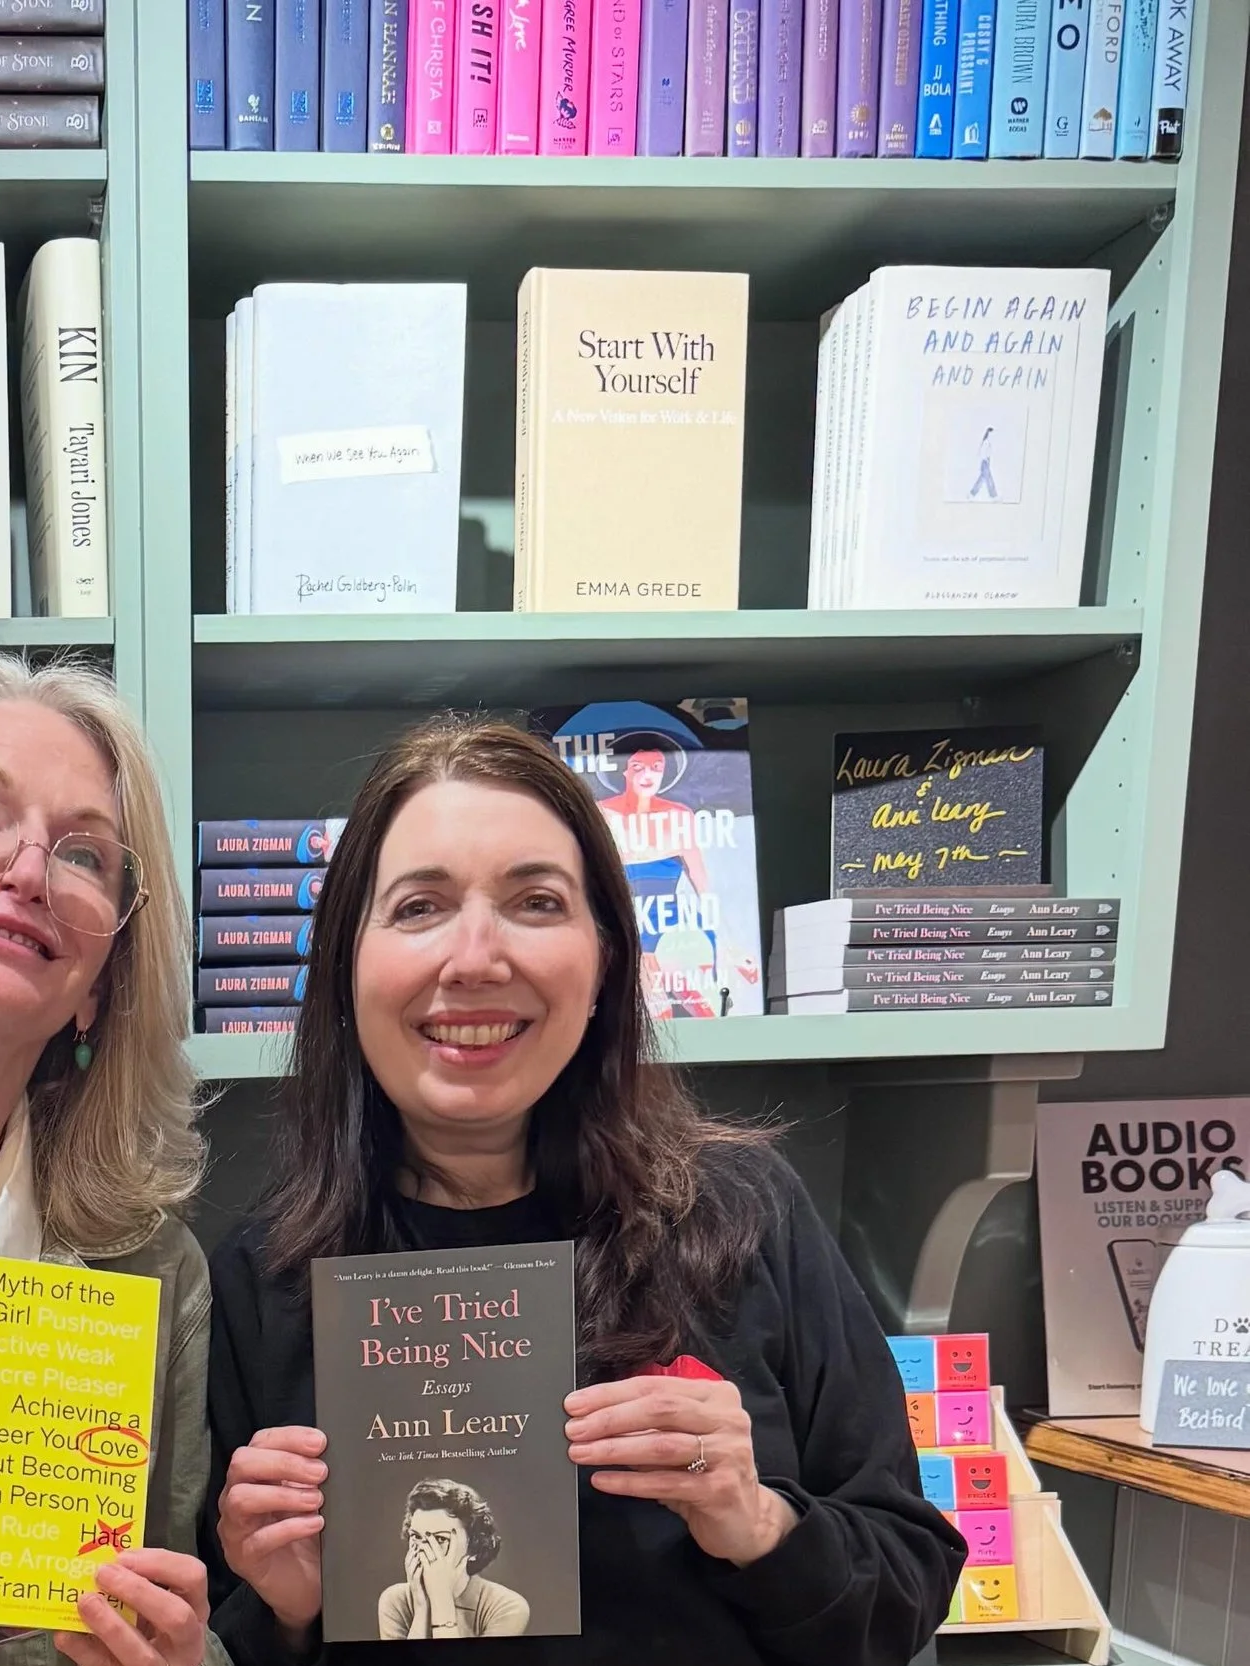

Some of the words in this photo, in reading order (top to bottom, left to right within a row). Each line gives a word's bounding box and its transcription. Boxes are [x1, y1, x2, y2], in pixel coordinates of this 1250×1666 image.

[424, 18, 446, 100] CHRISTA
[562, 36, 577, 93] MURDER
[1012, 36, 1036, 85] BROWN
[1163, 26, 1184, 92] AWAY
[610, 46, 624, 113] STARS
[923, 83, 951, 97] BOLA
[907, 296, 992, 320] BEGIN
[1004, 295, 1087, 321] AGAIN
[58, 326, 98, 384] KIN
[578, 329, 645, 360] Start
[652, 332, 715, 361] With
[923, 330, 976, 354] AND
[985, 331, 1064, 354] AGAIN
[594, 365, 702, 395] Yourself
[932, 365, 976, 387] AND
[982, 366, 1049, 389] AGAIN
[64, 422, 95, 485] Tayari
[295, 451, 324, 465] When
[327, 449, 343, 461] We
[346, 449, 364, 462] See
[390, 446, 420, 464] Again
[71, 488, 97, 548] Jones
[295, 574, 333, 603] Rachel
[337, 573, 417, 603] Goldberg-Polin
[576, 582, 631, 596] EMMA
[637, 582, 702, 597] GREDE
[552, 733, 618, 774] THE
[837, 747, 916, 785] Laura
[923, 738, 1034, 780] Zigman
[216, 838, 249, 852] LAURA
[252, 837, 293, 851] ZIGMAN
[614, 808, 738, 853] AUTHOR
[218, 884, 250, 898] LAURA
[253, 883, 293, 897] ZIGMAN
[875, 904, 893, 915] I've
[895, 904, 921, 915] Tried
[923, 904, 950, 916] Being
[951, 904, 974, 914] Nice
[1028, 904, 1050, 914] Ann
[1052, 904, 1080, 916] Leary
[1086, 1119, 1236, 1157] AUDIO
[1094, 1201, 1147, 1214] LISTEN
[1150, 1200, 1161, 1212] &
[1098, 1215, 1132, 1228] OUR
[51, 1277, 73, 1300] of
[79, 1281, 115, 1306] the
[369, 1296, 423, 1327] I've
[434, 1288, 521, 1322] Tried
[37, 1307, 143, 1341] Pushover
[56, 1340, 116, 1366] Weak
[360, 1337, 450, 1368] Being
[462, 1331, 532, 1361] Nice
[43, 1368, 127, 1398] Pleaser
[422, 1380, 472, 1397] Essays
[1173, 1374, 1197, 1397] We
[1207, 1376, 1238, 1397] love
[11, 1394, 122, 1431] Achieving
[128, 1413, 141, 1429] a
[366, 1413, 431, 1440] Ann
[442, 1409, 530, 1439] Leary
[1178, 1407, 1246, 1430] Bedford
[40, 1428, 80, 1451] You
[87, 1435, 139, 1459] Love
[378, 1451, 397, 1463] New
[398, 1451, 415, 1462] York
[417, 1450, 439, 1461] Times
[441, 1447, 485, 1460] Bestselling
[487, 1446, 518, 1457] Author
[22, 1455, 136, 1493] Becoming
[10, 1485, 89, 1513] Person
[95, 1496, 135, 1520] You
[1, 1516, 60, 1540] Rude
[80, 1523, 132, 1549] Hate
